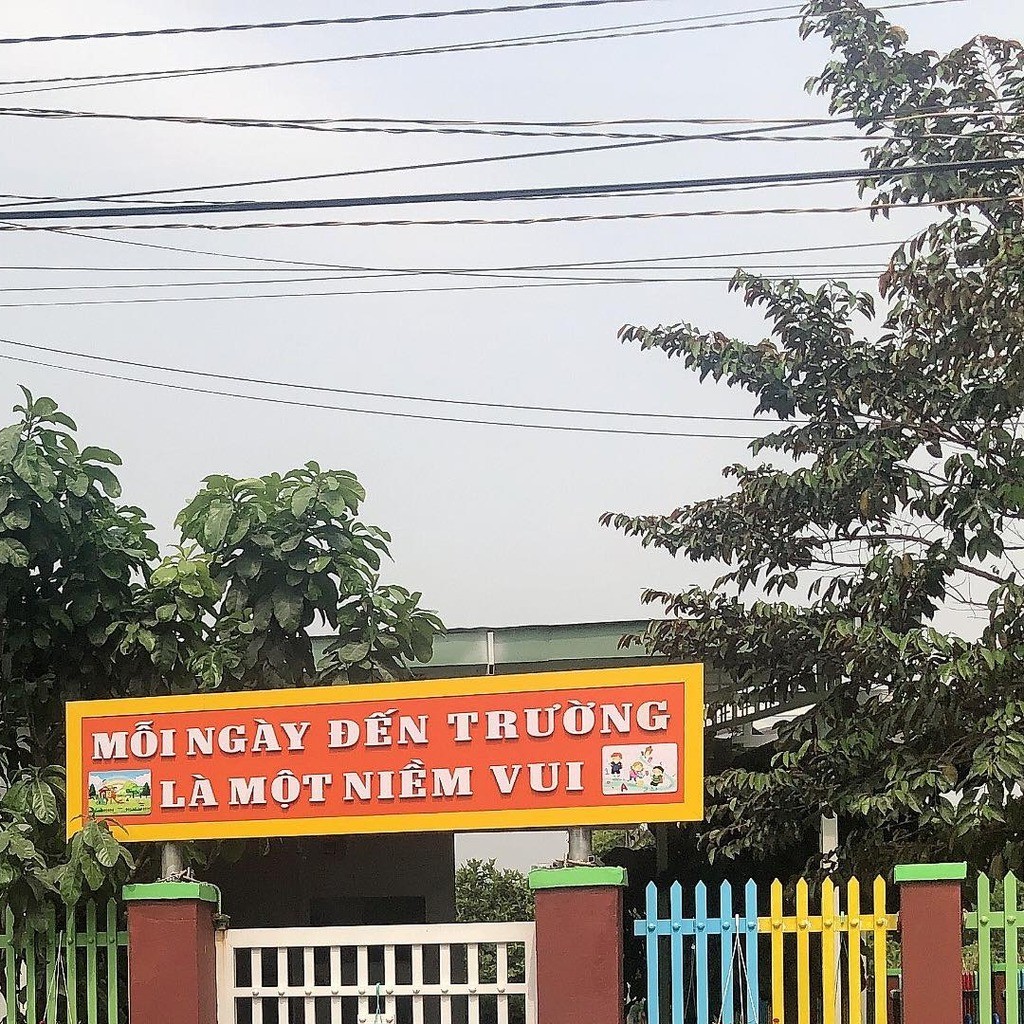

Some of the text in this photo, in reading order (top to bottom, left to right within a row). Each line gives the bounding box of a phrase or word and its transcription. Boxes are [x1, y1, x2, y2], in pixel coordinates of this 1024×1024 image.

[91, 700, 672, 760] MỖI NGÀY ĐẾN TRƯỜNG
[159, 758, 585, 811] LÀ MỘT NIỀM VUI
